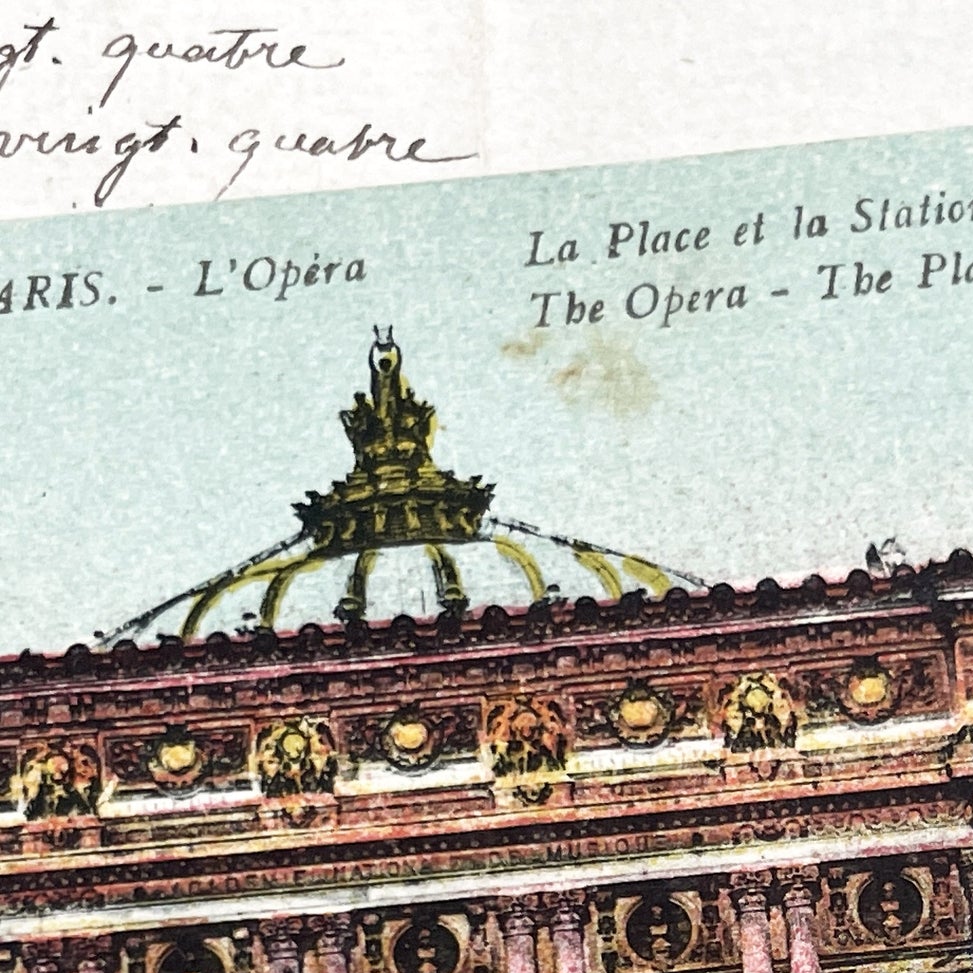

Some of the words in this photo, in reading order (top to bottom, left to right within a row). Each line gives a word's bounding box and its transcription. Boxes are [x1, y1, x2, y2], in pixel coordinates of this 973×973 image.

[99, 28, 346, 108] quatre
[523, 230, 580, 268] La
[607, 220, 711, 260] Place
[733, 212, 765, 247] et
[793, 205, 829, 241] la
[193, 252, 367, 302] L'Opéra
[530, 290, 605, 329] The
[625, 282, 749, 329] Opera
[816, 261, 893, 301] The
